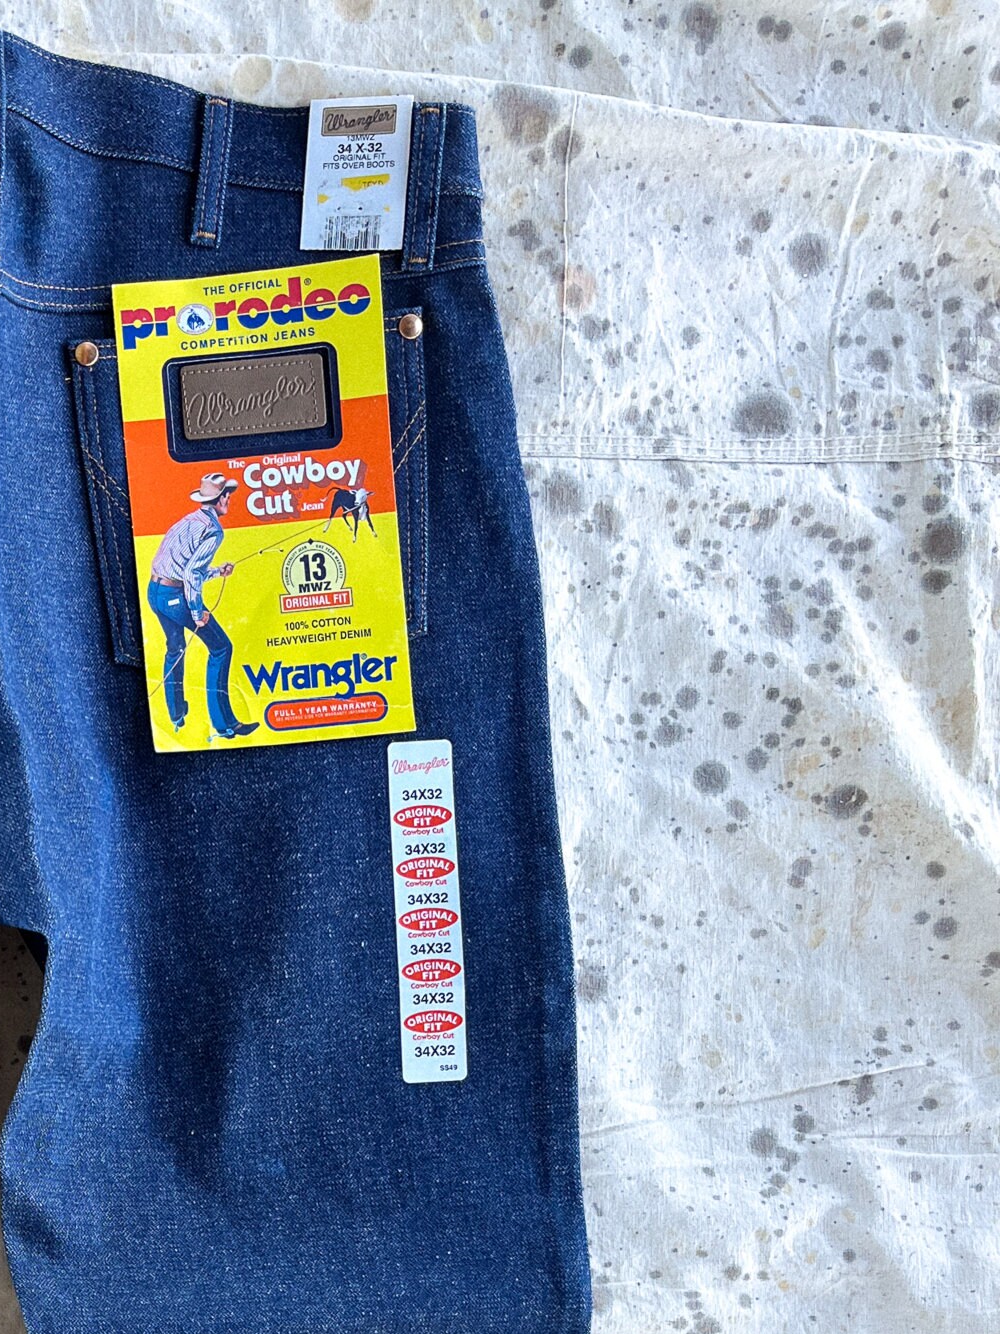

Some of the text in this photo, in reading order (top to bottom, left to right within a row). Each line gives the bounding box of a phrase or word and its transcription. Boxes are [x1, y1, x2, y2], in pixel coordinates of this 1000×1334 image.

[325, 109, 395, 131] Wrangler
[337, 144, 352, 154] 34
[367, 160, 395, 168] BOOTS
[203, 278, 282, 296] THE OFFICIAL
[181, 327, 316, 350] COMPETITION JEANS
[186, 376, 315, 427] Wrangler
[227, 453, 301, 469] The Original
[243, 457, 361, 489] Cowboy
[246, 489, 324, 517] Cut Jean
[300, 553, 327, 582] 13
[299, 581, 332, 593] MWZ
[285, 593, 348, 609] ORIGINAL FIT
[284, 616, 352, 632] 100% COTTON
[266, 628, 372, 647] HEAVYWEIGHT DENIM
[242, 653, 397, 699] Wrangler
[274, 709, 296, 717] FULL
[305, 705, 328, 714] YEAR
[330, 700, 377, 711] WARRANTY
[392, 757, 448, 775] Wrangler
[402, 788, 443, 801] 34X32
[397, 808, 447, 822] ORIGINAL
[413, 817, 432, 827] FIT
[405, 843, 446, 855] 34X32
[399, 860, 450, 874] ORIGINAL
[416, 869, 435, 878] FIT
[405, 880, 433, 888] Cowboy
[407, 893, 449, 905] 34X32
[402, 911, 453, 925] ORIGINAL
[419, 920, 438, 929] FIT
[408, 931, 436, 939] Cowboy
[410, 942, 452, 955] 34X32
[405, 962, 456, 976] ORIGINAL
[422, 971, 441, 980] FIT
[411, 982, 439, 990] Cowboy
[412, 992, 454, 1005] 34X32
[407, 1013, 458, 1027] ORIGINAL
[424, 1022, 443, 1032] FIT
[415, 1045, 456, 1058] 34X32
